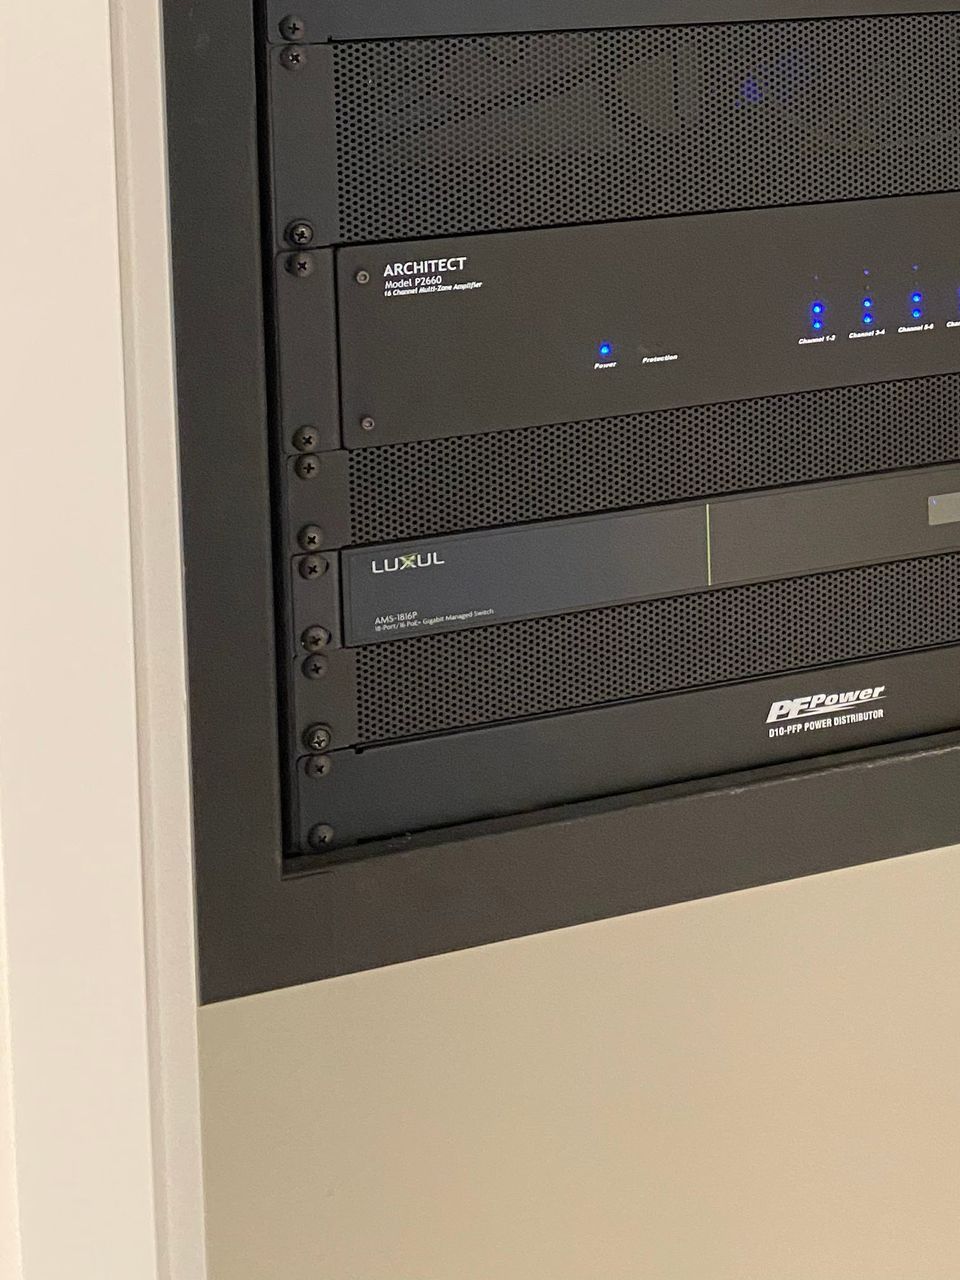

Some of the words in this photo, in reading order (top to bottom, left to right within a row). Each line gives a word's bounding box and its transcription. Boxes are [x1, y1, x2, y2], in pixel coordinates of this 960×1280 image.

[383, 256, 467, 277] ARCHITECT
[384, 279, 412, 290] Model
[415, 275, 442, 287] P2660
[393, 288, 418, 297] Channel
[418, 285, 453, 294] Multi-Zone
[453, 281, 483, 292] Amplifier
[849, 331, 874, 339] Channel
[898, 325, 923, 333] Channel
[798, 336, 825, 345] Channel
[594, 361, 616, 370] Power
[642, 353, 678, 364] Protection
[371, 552, 445, 574] LUXUL
[374, 611, 418, 625] AMS-1816P
[422, 616, 444, 626] Gigabit
[445, 611, 473, 621] Managed
[474, 608, 494, 617] Switch
[768, 723, 802, 738] D10-PFP
[804, 718, 832, 732] POWER
[833, 709, 884, 726] DISTRIBUTOR
